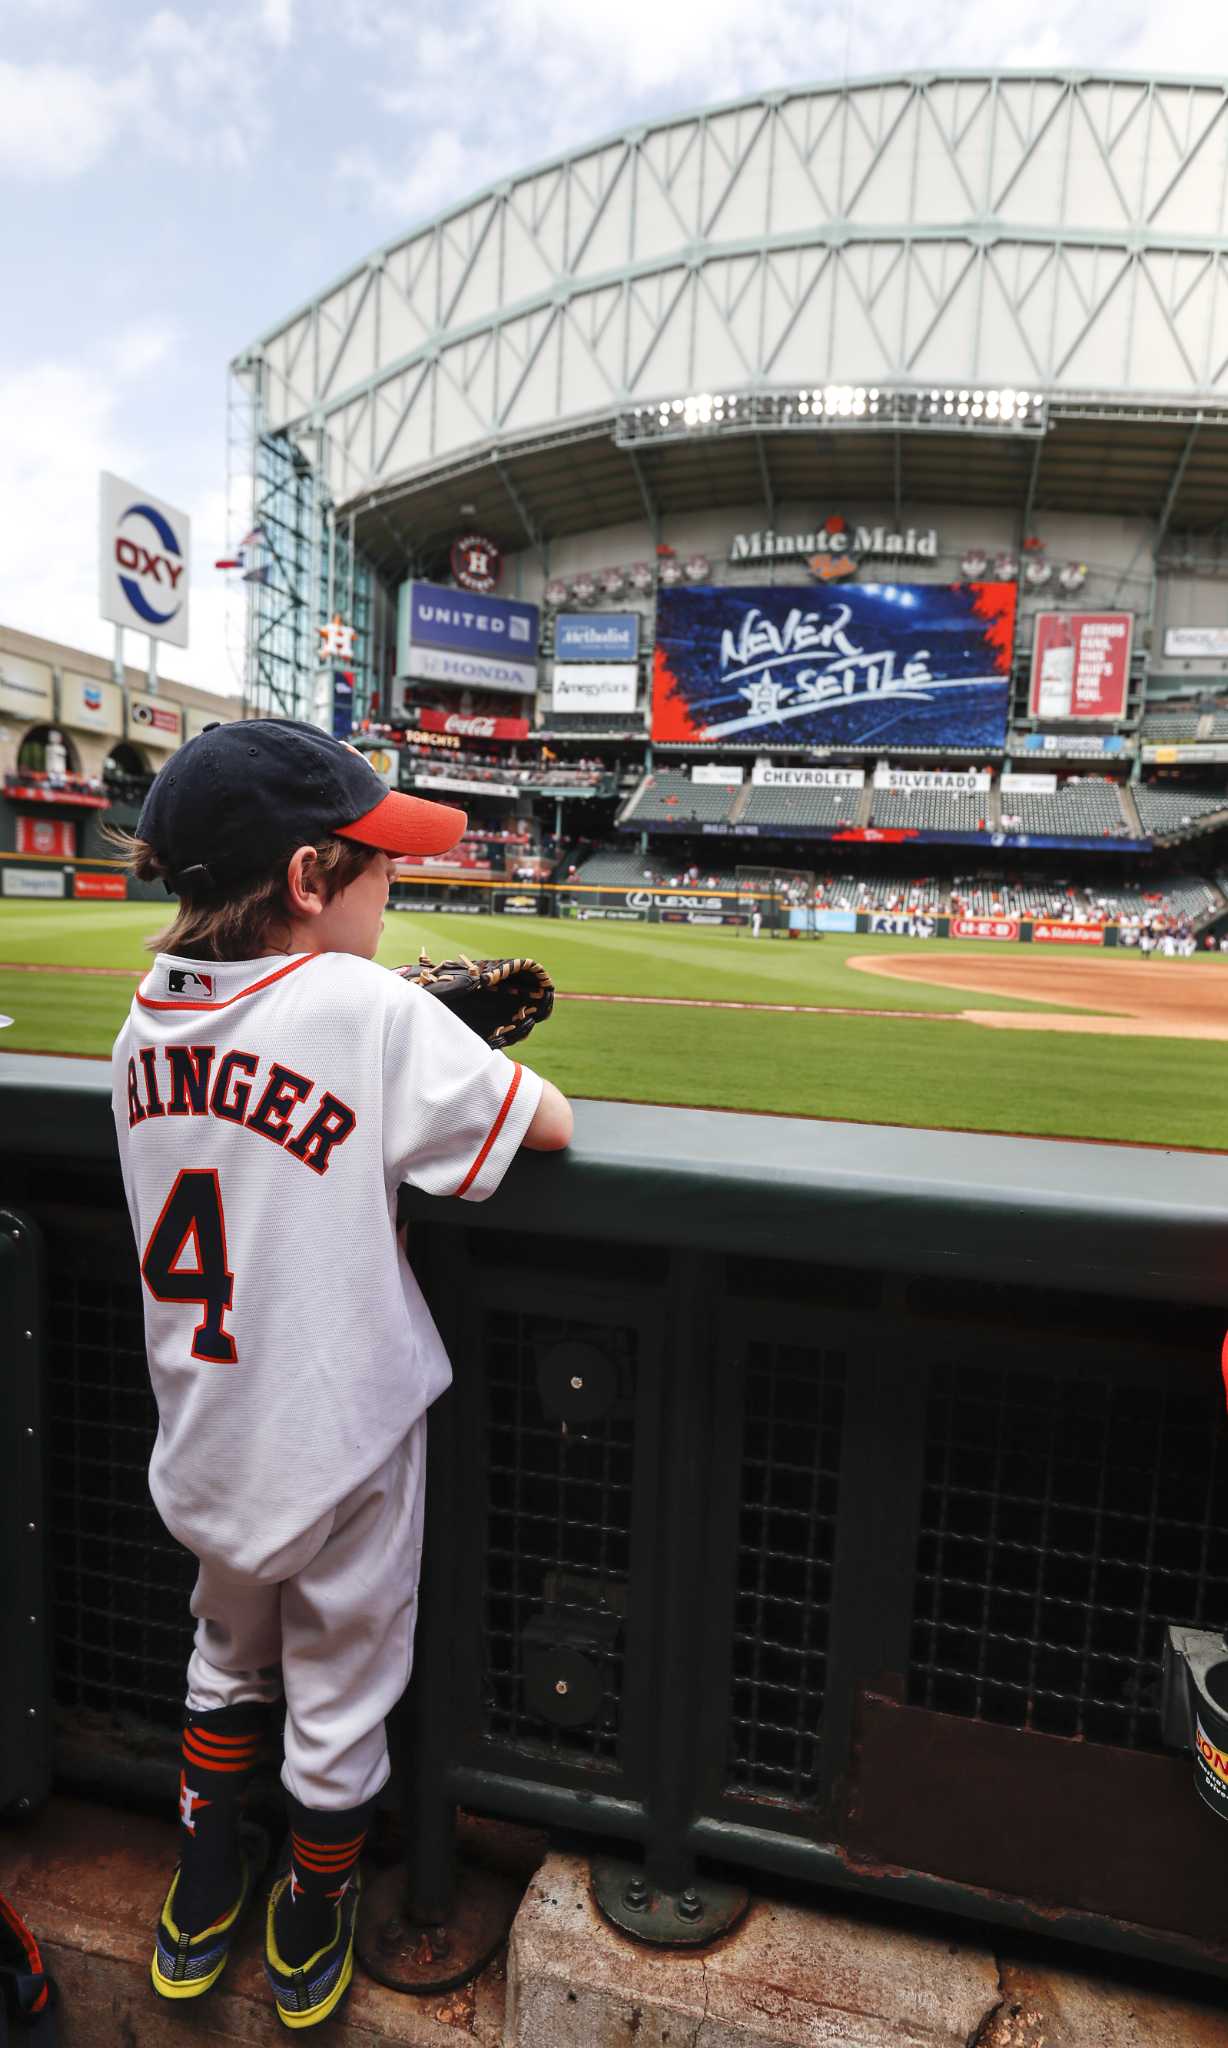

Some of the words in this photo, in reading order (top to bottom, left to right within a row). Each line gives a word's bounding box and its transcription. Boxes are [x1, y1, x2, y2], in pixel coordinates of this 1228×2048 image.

[731, 529, 848, 560] Minute
[854, 526, 938, 557] Maid
[115, 537, 183, 589] OXY
[418, 605, 506, 632] UNITED
[720, 603, 864, 669] NEVER
[443, 655, 525, 684] HONDA
[789, 650, 933, 705] SETTLE
[763, 771, 853, 785] CHEVROLET
[889, 774, 977, 789] SILVERADO
[654, 895, 723, 909] LEXUS
[960, 921, 1010, 937] H-E-B
[141, 1167, 238, 1364] 4
